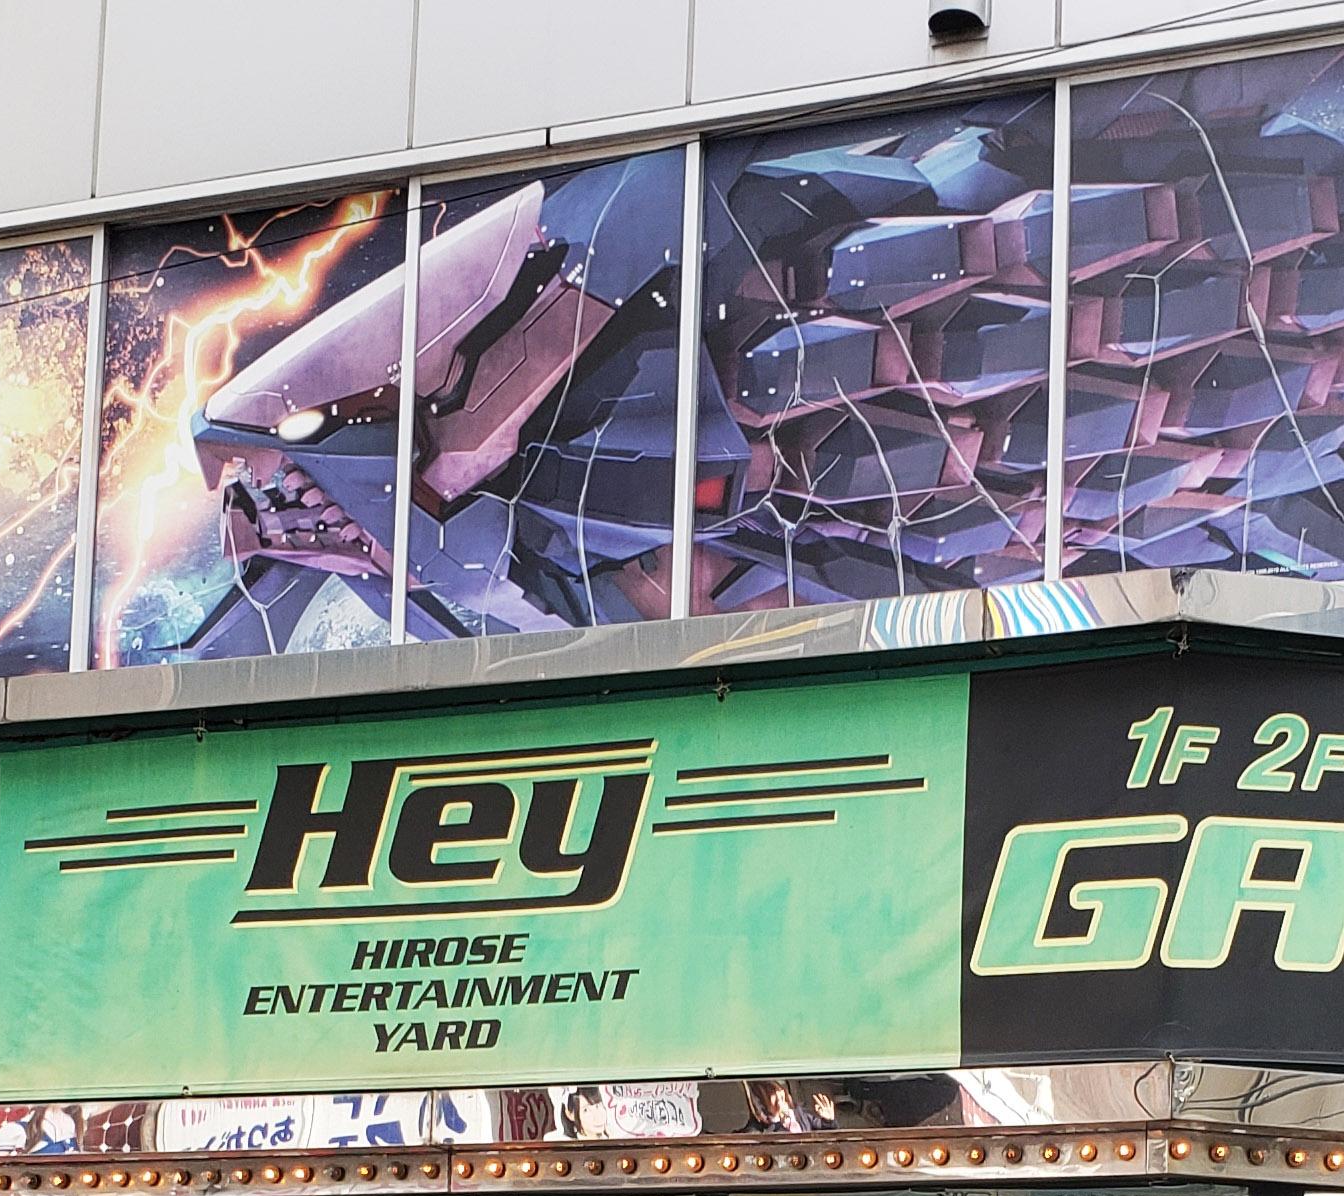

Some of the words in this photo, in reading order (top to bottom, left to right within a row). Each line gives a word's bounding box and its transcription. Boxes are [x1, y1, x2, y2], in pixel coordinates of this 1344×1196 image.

[1126, 706, 1220, 790] 1F
[232, 739, 659, 926] Hey
[352, 933, 530, 970] HIROSE
[243, 968, 640, 1017] ENTERTAINMENT
[375, 1018, 501, 1053] YARD
